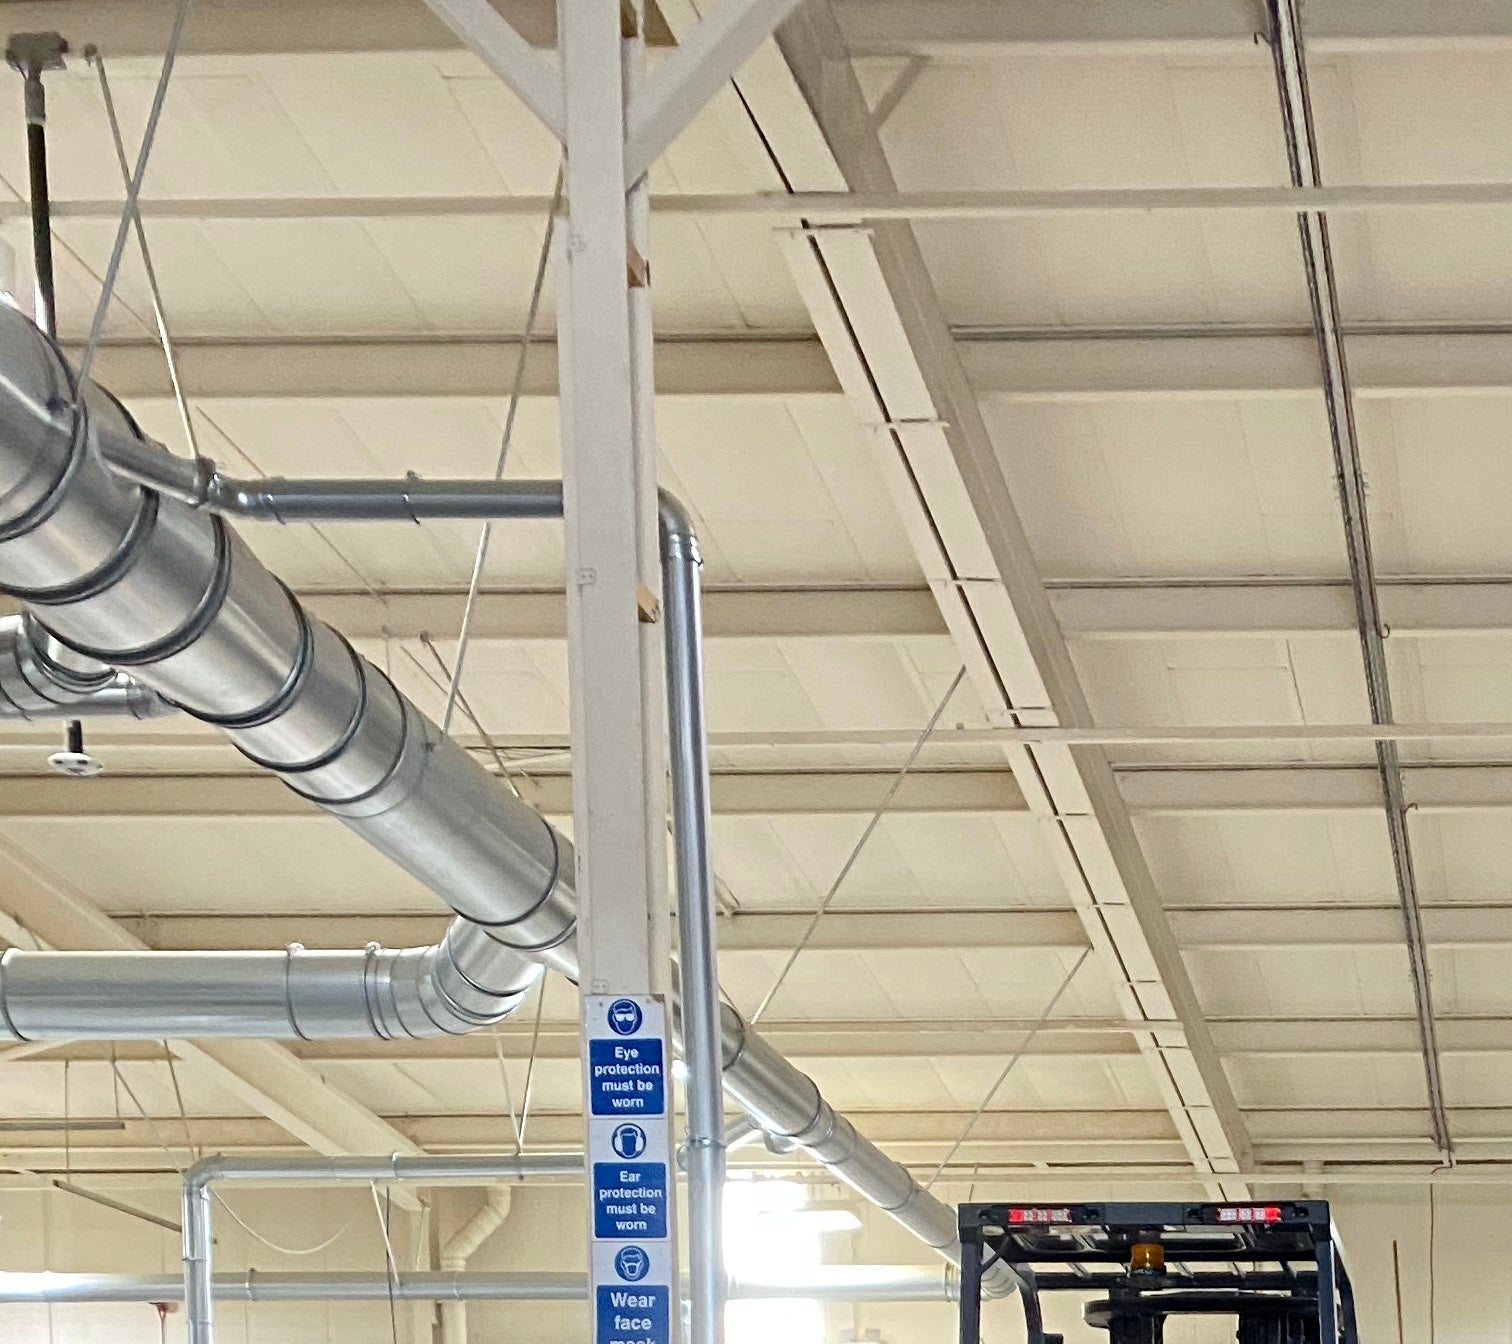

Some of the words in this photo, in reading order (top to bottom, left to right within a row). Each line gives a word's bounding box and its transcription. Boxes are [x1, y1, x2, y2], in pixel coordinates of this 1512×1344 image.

[615, 1046, 639, 1060] Eye
[594, 1063, 660, 1077] protection
[602, 1080, 634, 1091] must
[637, 1080, 654, 1091] be
[612, 1098, 644, 1108] worn
[620, 1170, 641, 1182] Ear
[599, 1187, 663, 1201] protection
[606, 1203, 637, 1214] must
[640, 1203, 656, 1214] be
[615, 1220, 648, 1230] worn
[610, 1292, 657, 1308] Wear
[614, 1315, 652, 1330] face
